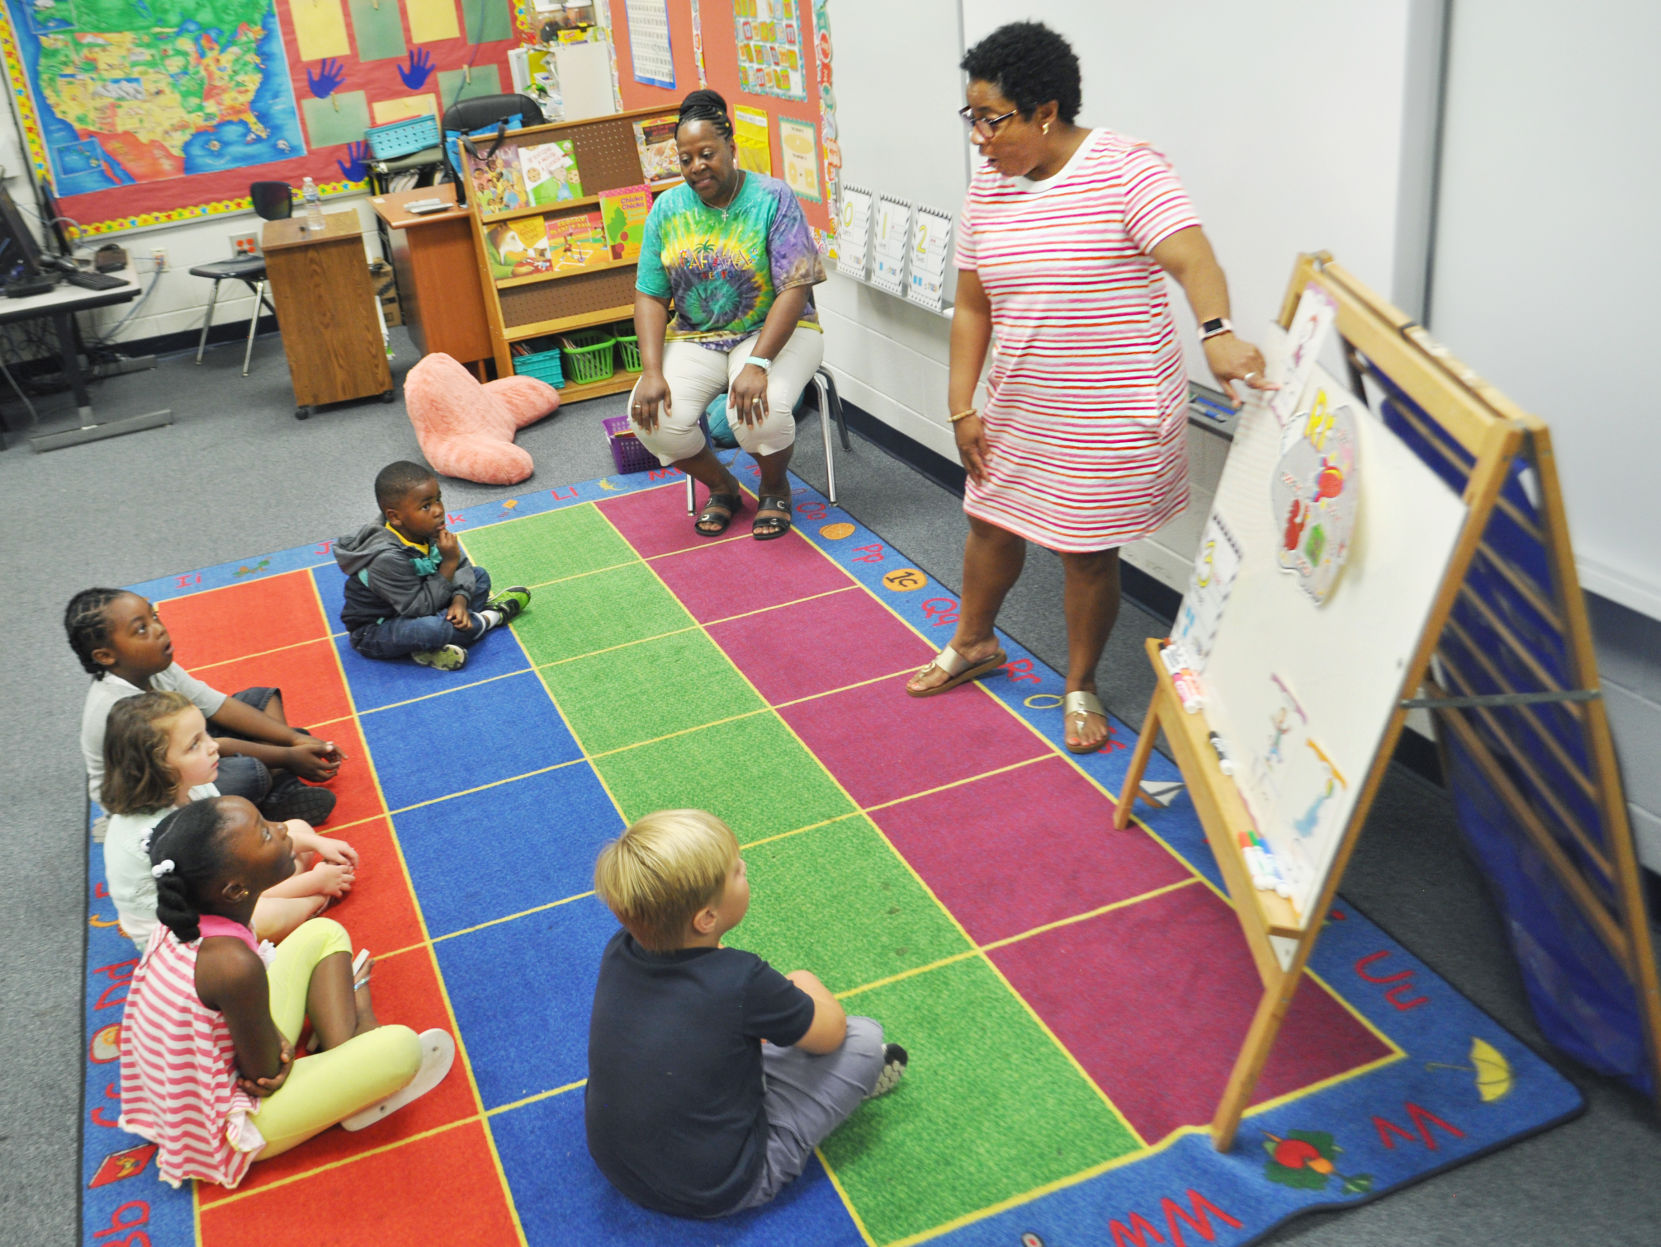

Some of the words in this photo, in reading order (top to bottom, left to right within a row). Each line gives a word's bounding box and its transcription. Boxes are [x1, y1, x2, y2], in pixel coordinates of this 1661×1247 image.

[843, 201, 854, 227] 0
[916, 225, 928, 254] 2
[796, 502, 827, 520] Oo
[851, 543, 884, 563] Pp
[1197, 540, 1216, 588] 3
[174, 572, 202, 589] Ii
[885, 571, 918, 588] 1c
[921, 597, 961, 627] Qq
[998, 658, 1042, 684] Rr
[1355, 949, 1428, 1011] Uu
[1371, 1101, 1467, 1150] Vv
[1108, 1188, 1243, 1247] Ww
